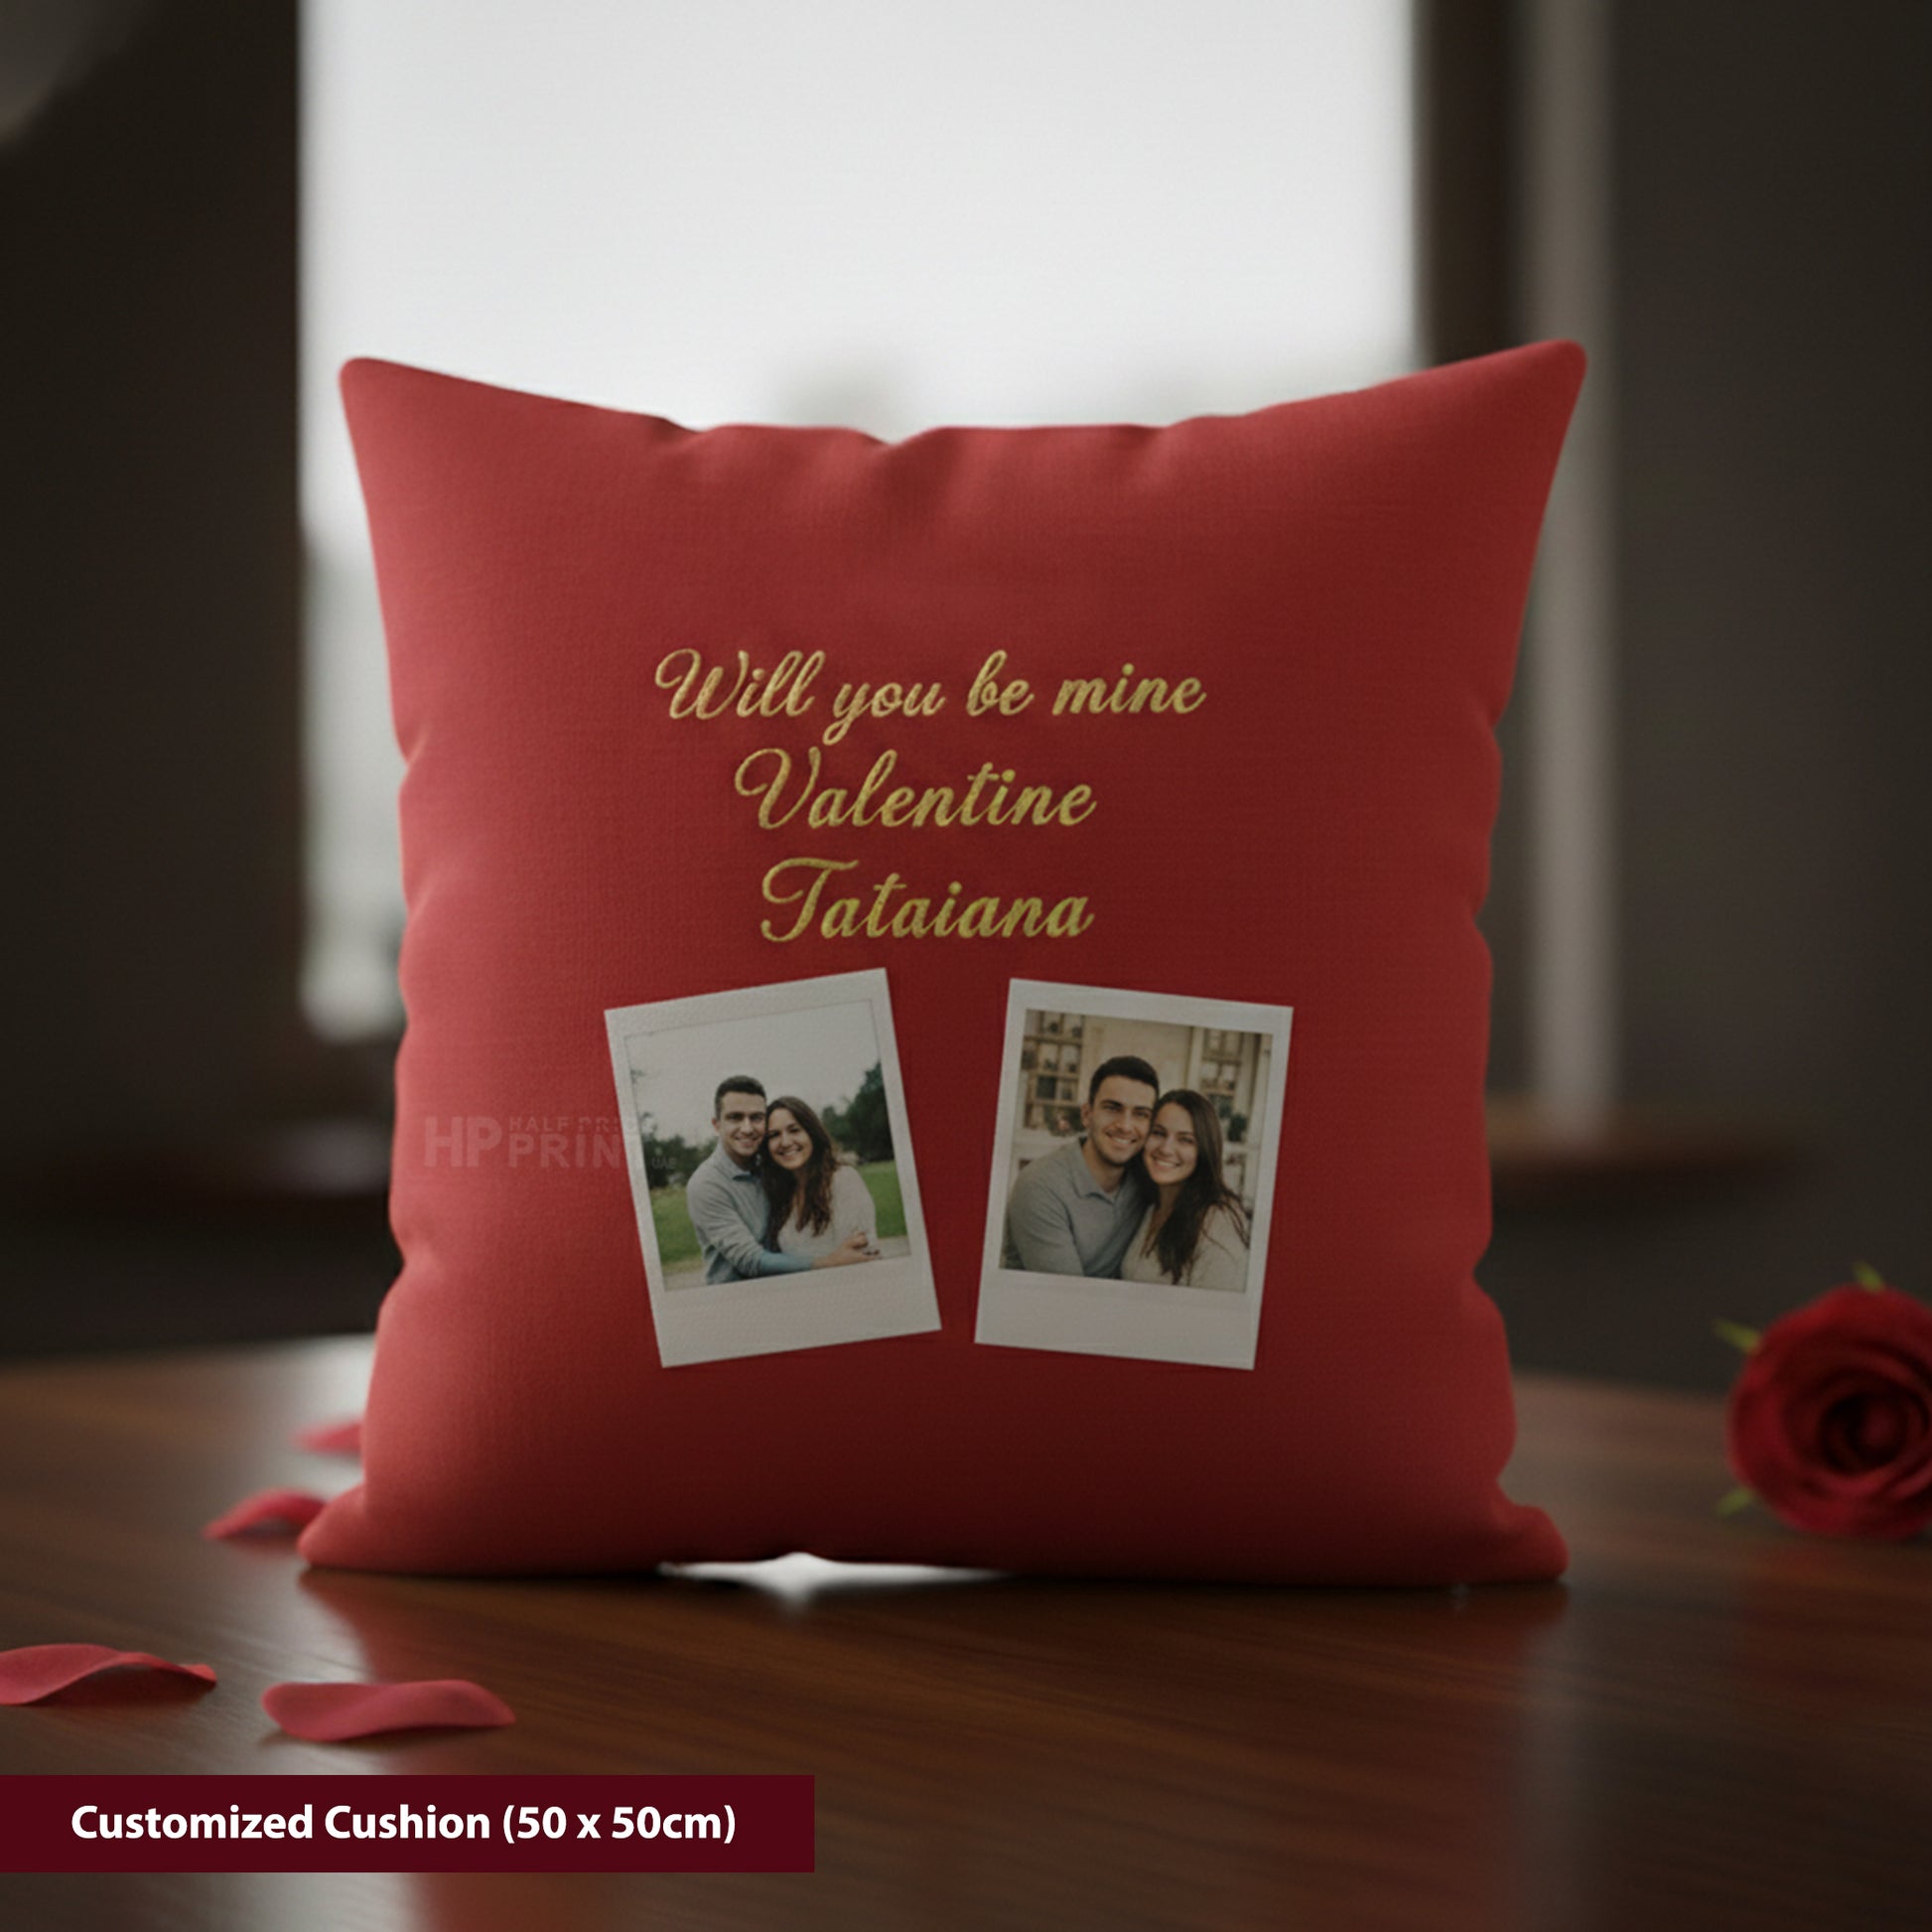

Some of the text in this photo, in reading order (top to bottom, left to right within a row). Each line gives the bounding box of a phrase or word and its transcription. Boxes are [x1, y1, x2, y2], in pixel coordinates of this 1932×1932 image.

[654, 648, 1207, 746] Will you be mine
[735, 746, 1097, 829] Valentine
[760, 857, 1094, 942] Tataiana
